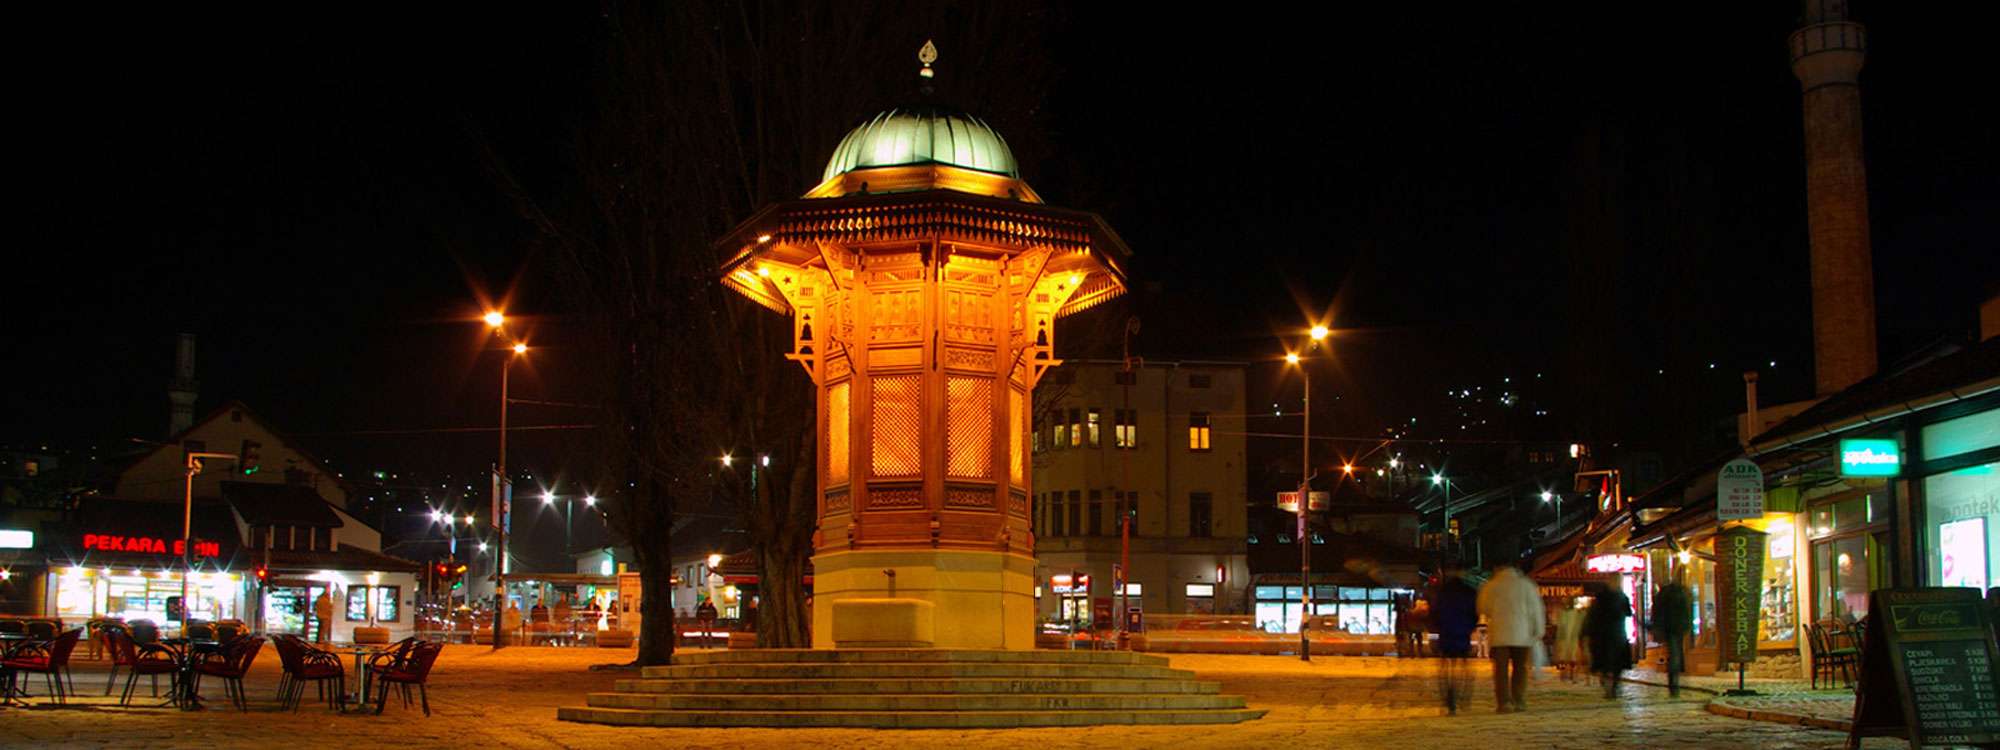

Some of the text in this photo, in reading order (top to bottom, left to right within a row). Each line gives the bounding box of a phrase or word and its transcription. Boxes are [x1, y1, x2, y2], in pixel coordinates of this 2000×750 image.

[1724, 464, 1757, 473] ADK
[83, 533, 220, 558] PEKARA EIN
[1736, 536, 1748, 655] DONER KEBAP
